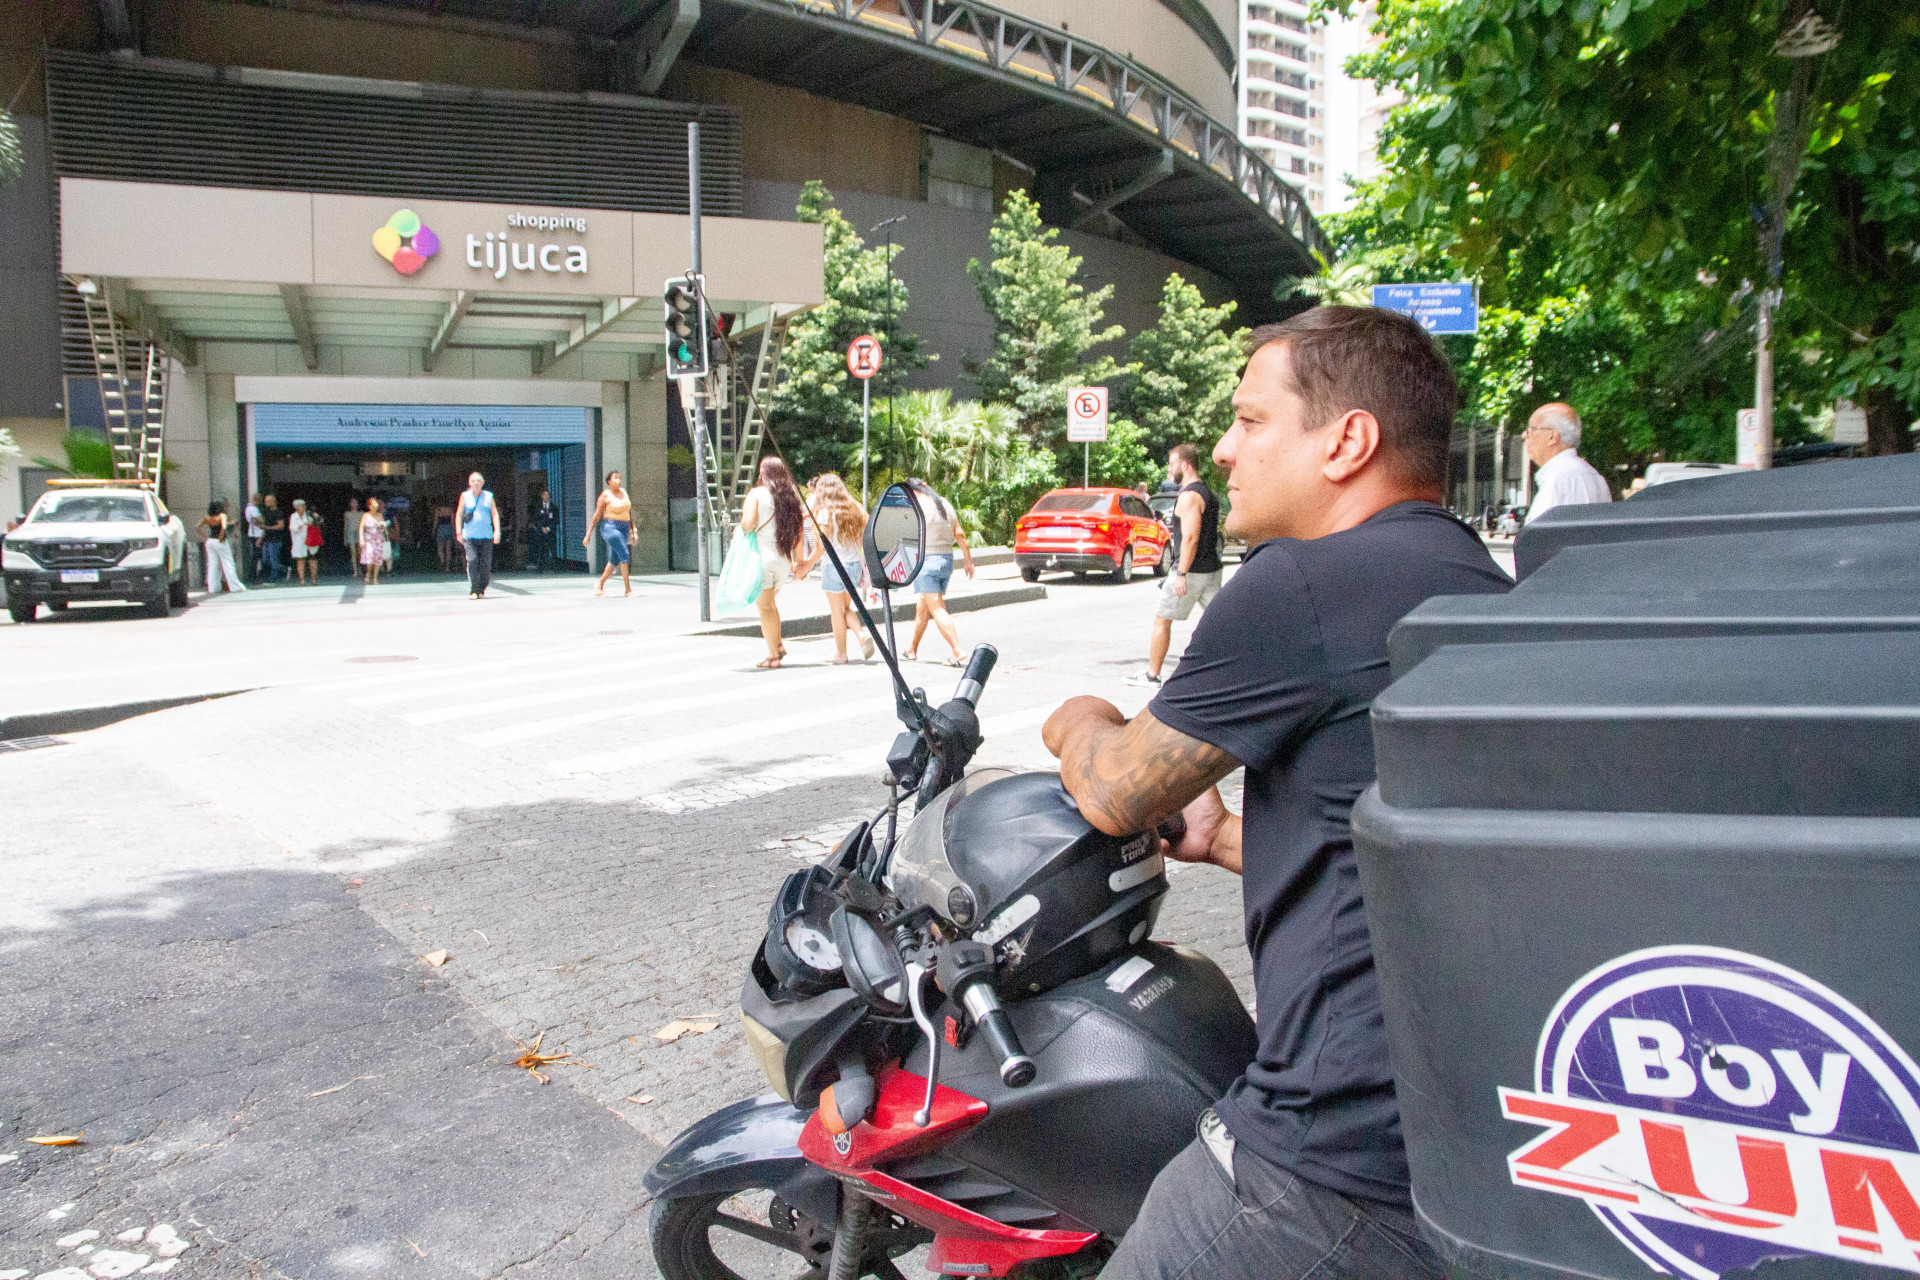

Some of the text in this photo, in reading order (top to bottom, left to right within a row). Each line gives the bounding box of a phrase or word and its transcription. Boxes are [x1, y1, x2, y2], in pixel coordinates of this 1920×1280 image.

[507, 211, 586, 232] shopping
[466, 231, 588, 279] tijuca
[1128, 975, 1177, 1011] YAMAHA
[1609, 1016, 1851, 1135] Boy
